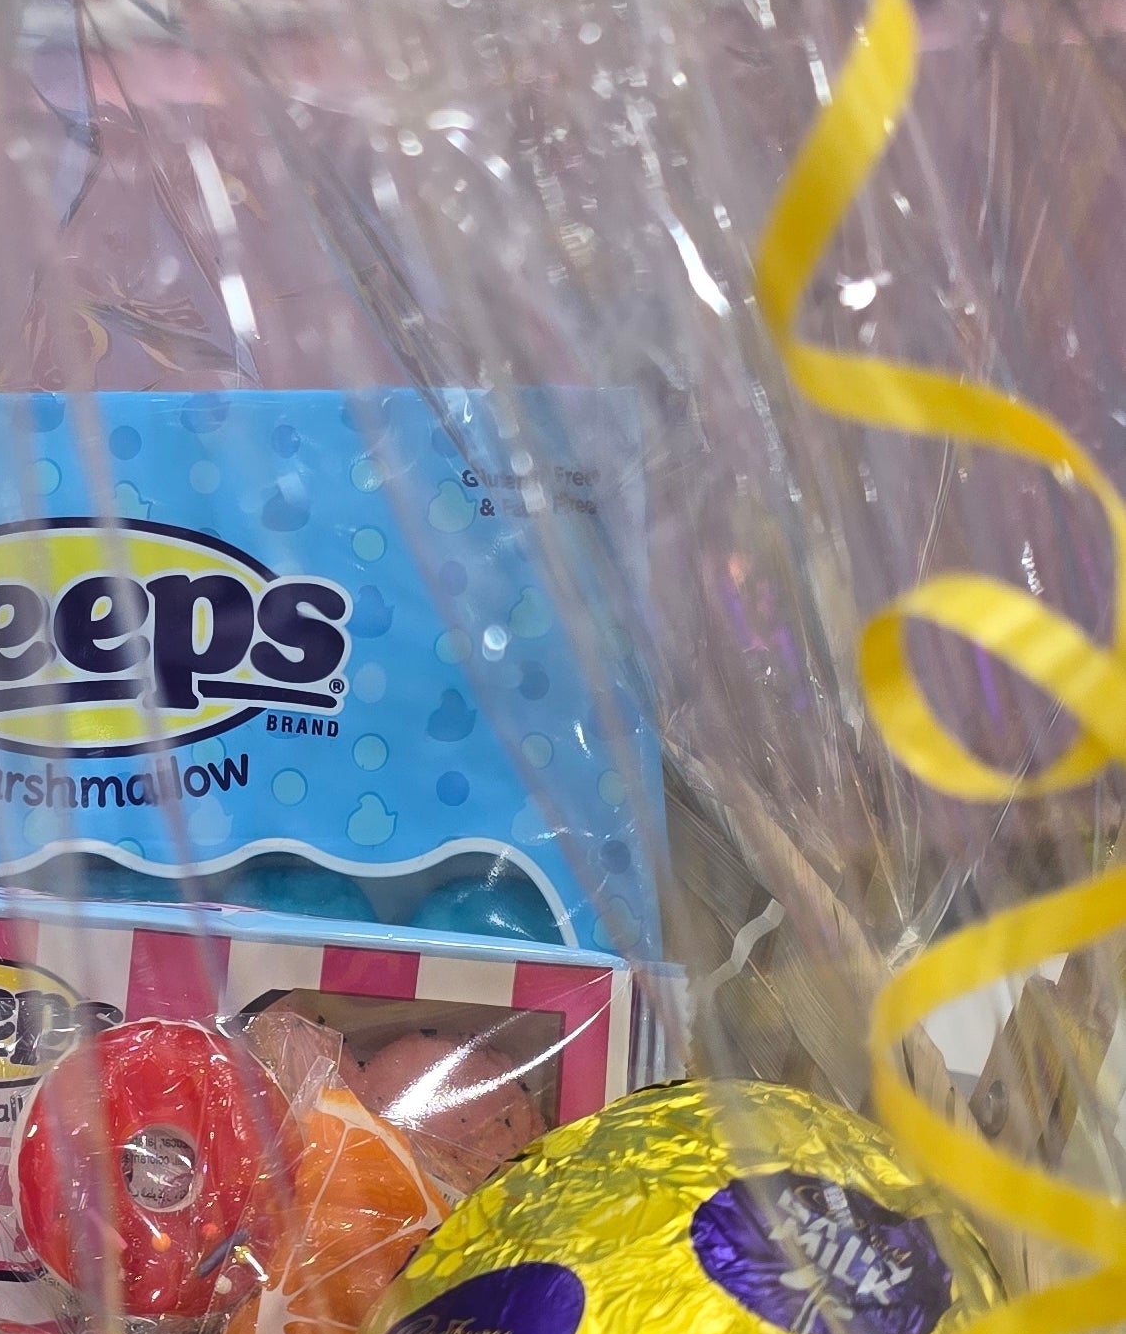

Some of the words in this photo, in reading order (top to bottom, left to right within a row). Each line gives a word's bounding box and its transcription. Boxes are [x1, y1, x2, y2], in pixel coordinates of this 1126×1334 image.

[479, 498, 495, 517] &
[266, 714, 341, 738] BRAND
[768, 1218, 891, 1306] MILK
